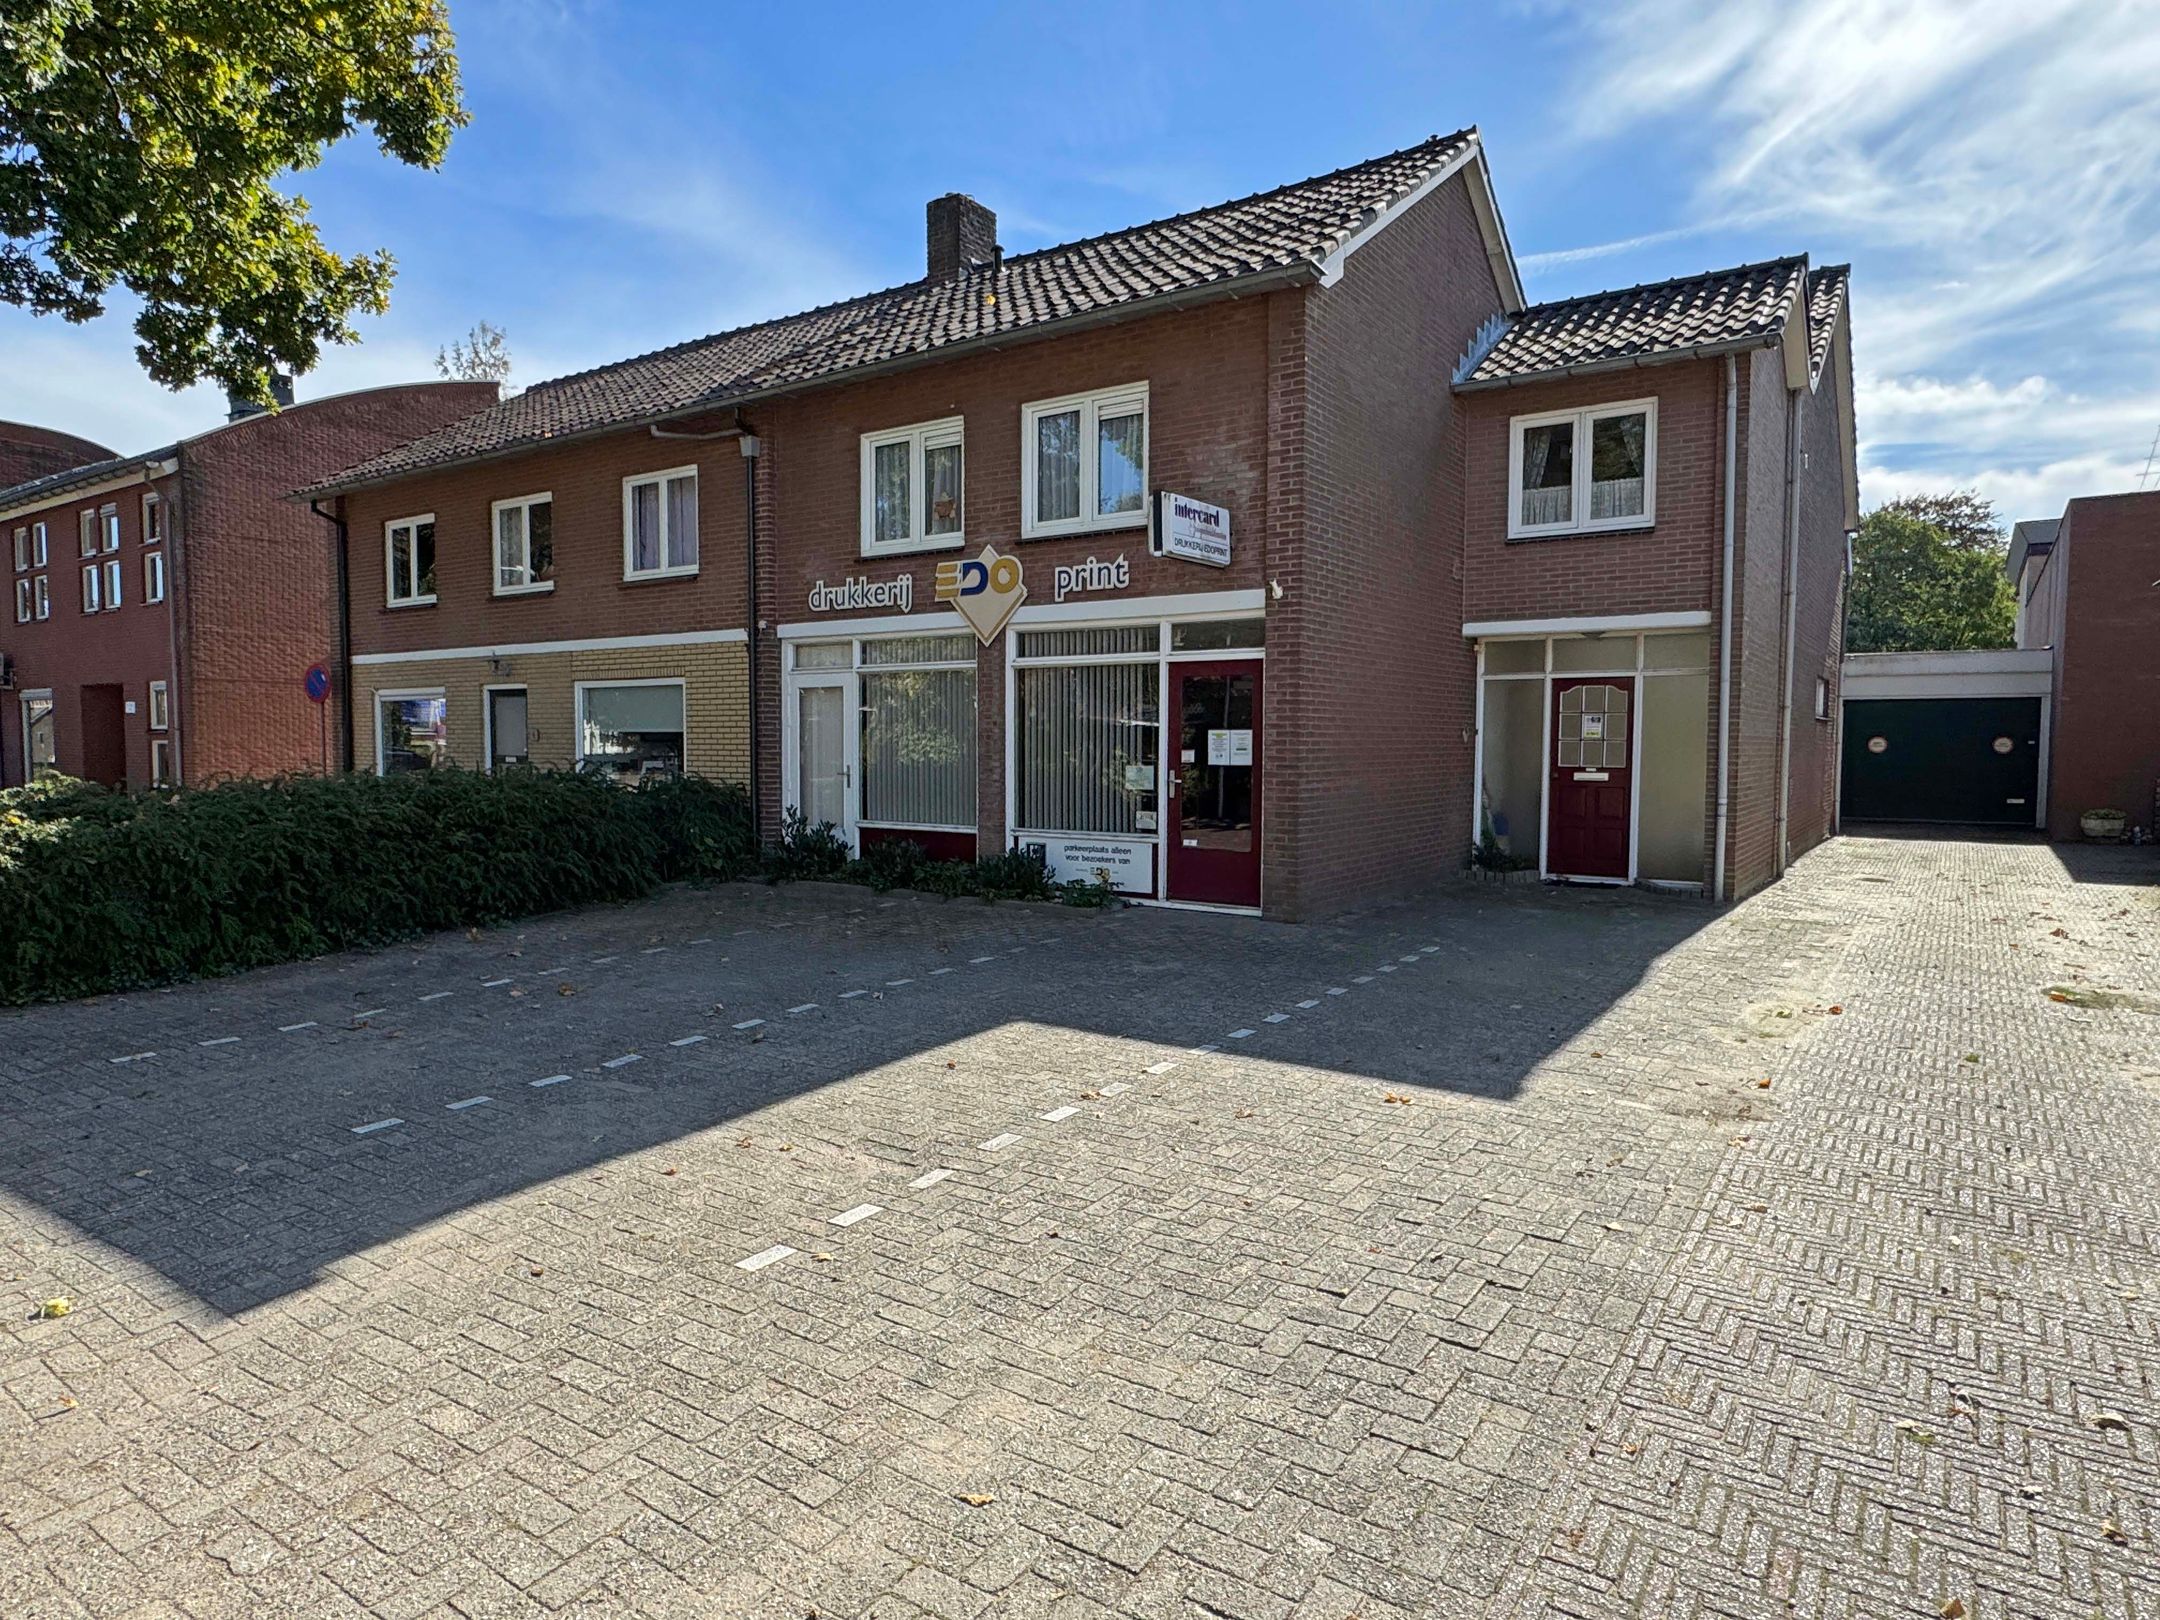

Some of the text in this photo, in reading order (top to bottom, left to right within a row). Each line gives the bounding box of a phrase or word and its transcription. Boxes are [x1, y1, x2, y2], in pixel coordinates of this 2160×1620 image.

[1174, 497, 1220, 528] intercard
[809, 554, 1129, 612] drukkerij EDO print
[1063, 845, 1132, 855] parkeerplaats alleen
[1065, 854, 1080, 862] voor
[1081, 855, 1116, 864] bezoekers
